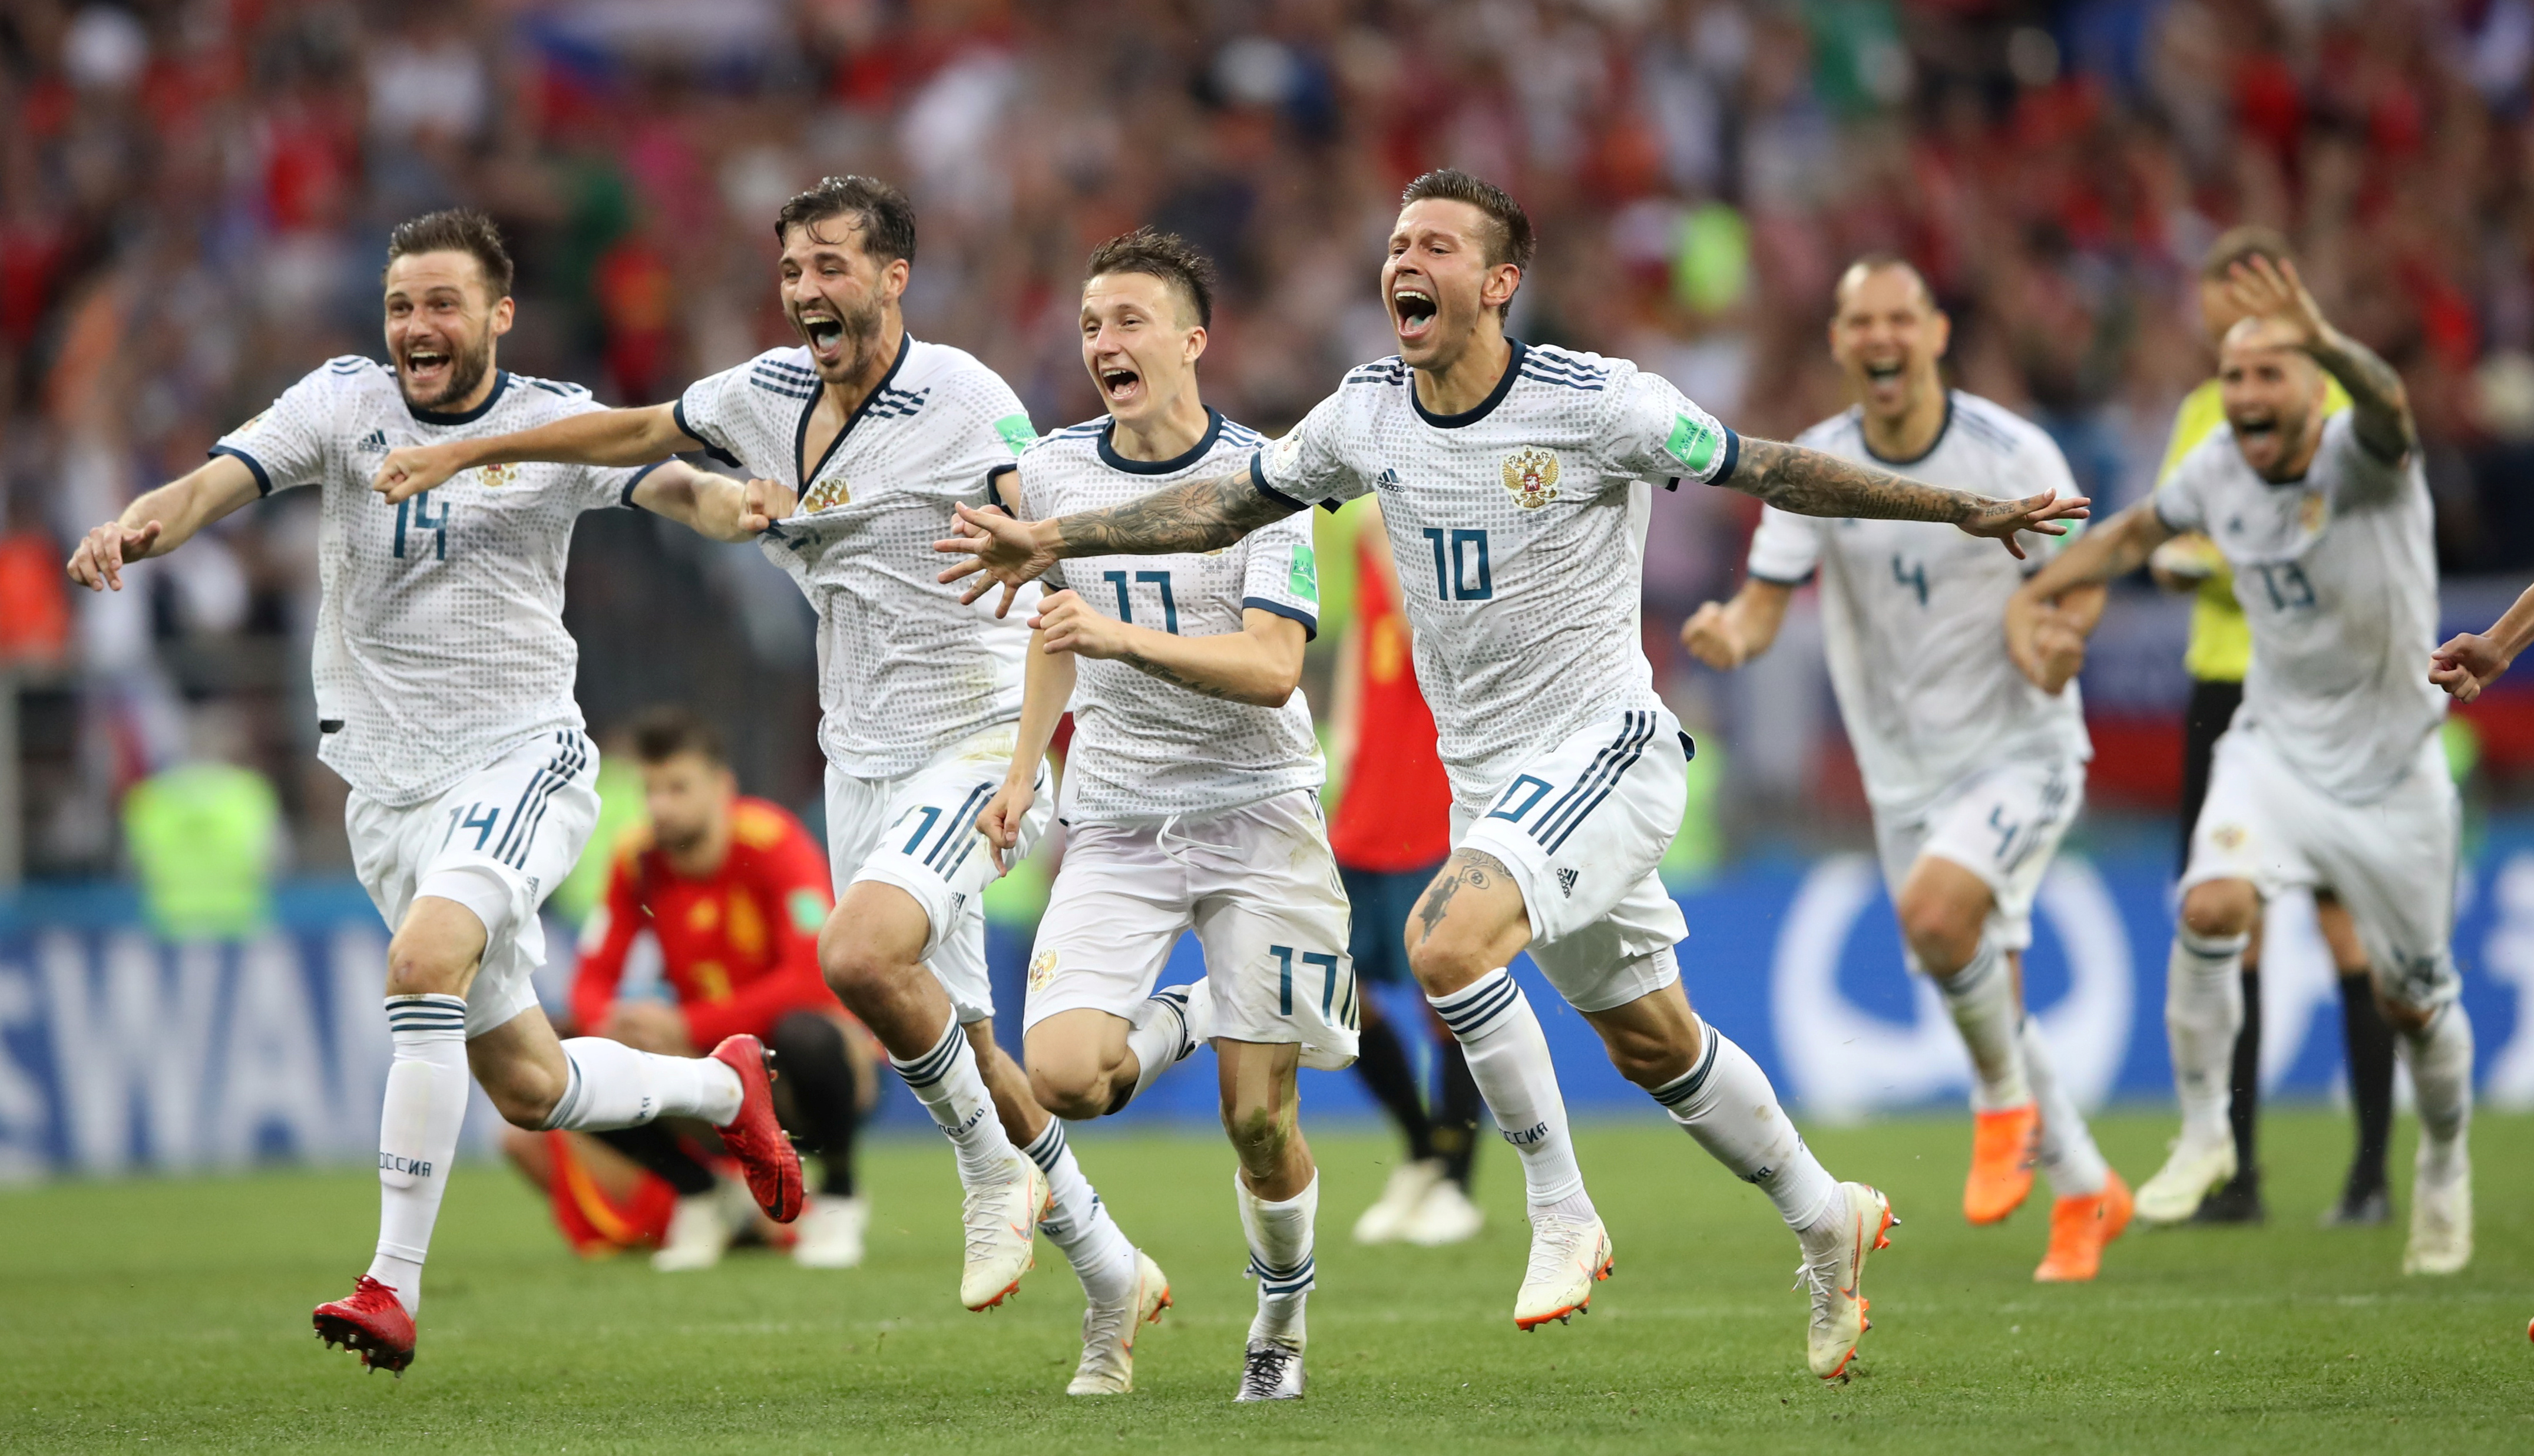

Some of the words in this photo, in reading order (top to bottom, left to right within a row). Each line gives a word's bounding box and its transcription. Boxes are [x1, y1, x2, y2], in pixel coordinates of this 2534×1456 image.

[1698, 428, 1708, 443] FIFA
[1377, 481, 1405, 493] adidas
[1985, 503, 2016, 517] HOPE
[393, 491, 449, 561] 14
[1423, 527, 1493, 601] 10
[1890, 551, 1928, 607] 4
[2256, 560, 2318, 613] 13
[1103, 570, 1179, 636] 17
[1484, 773, 1555, 823] 0
[440, 801, 501, 853] 14
[1989, 802, 2019, 858] 4
[1557, 868, 1571, 899] adidas
[1269, 944, 1338, 1027] 17
[1498, 1121, 1549, 1144] ОССИЯ
[379, 1151, 432, 1177] ОССИЯ
